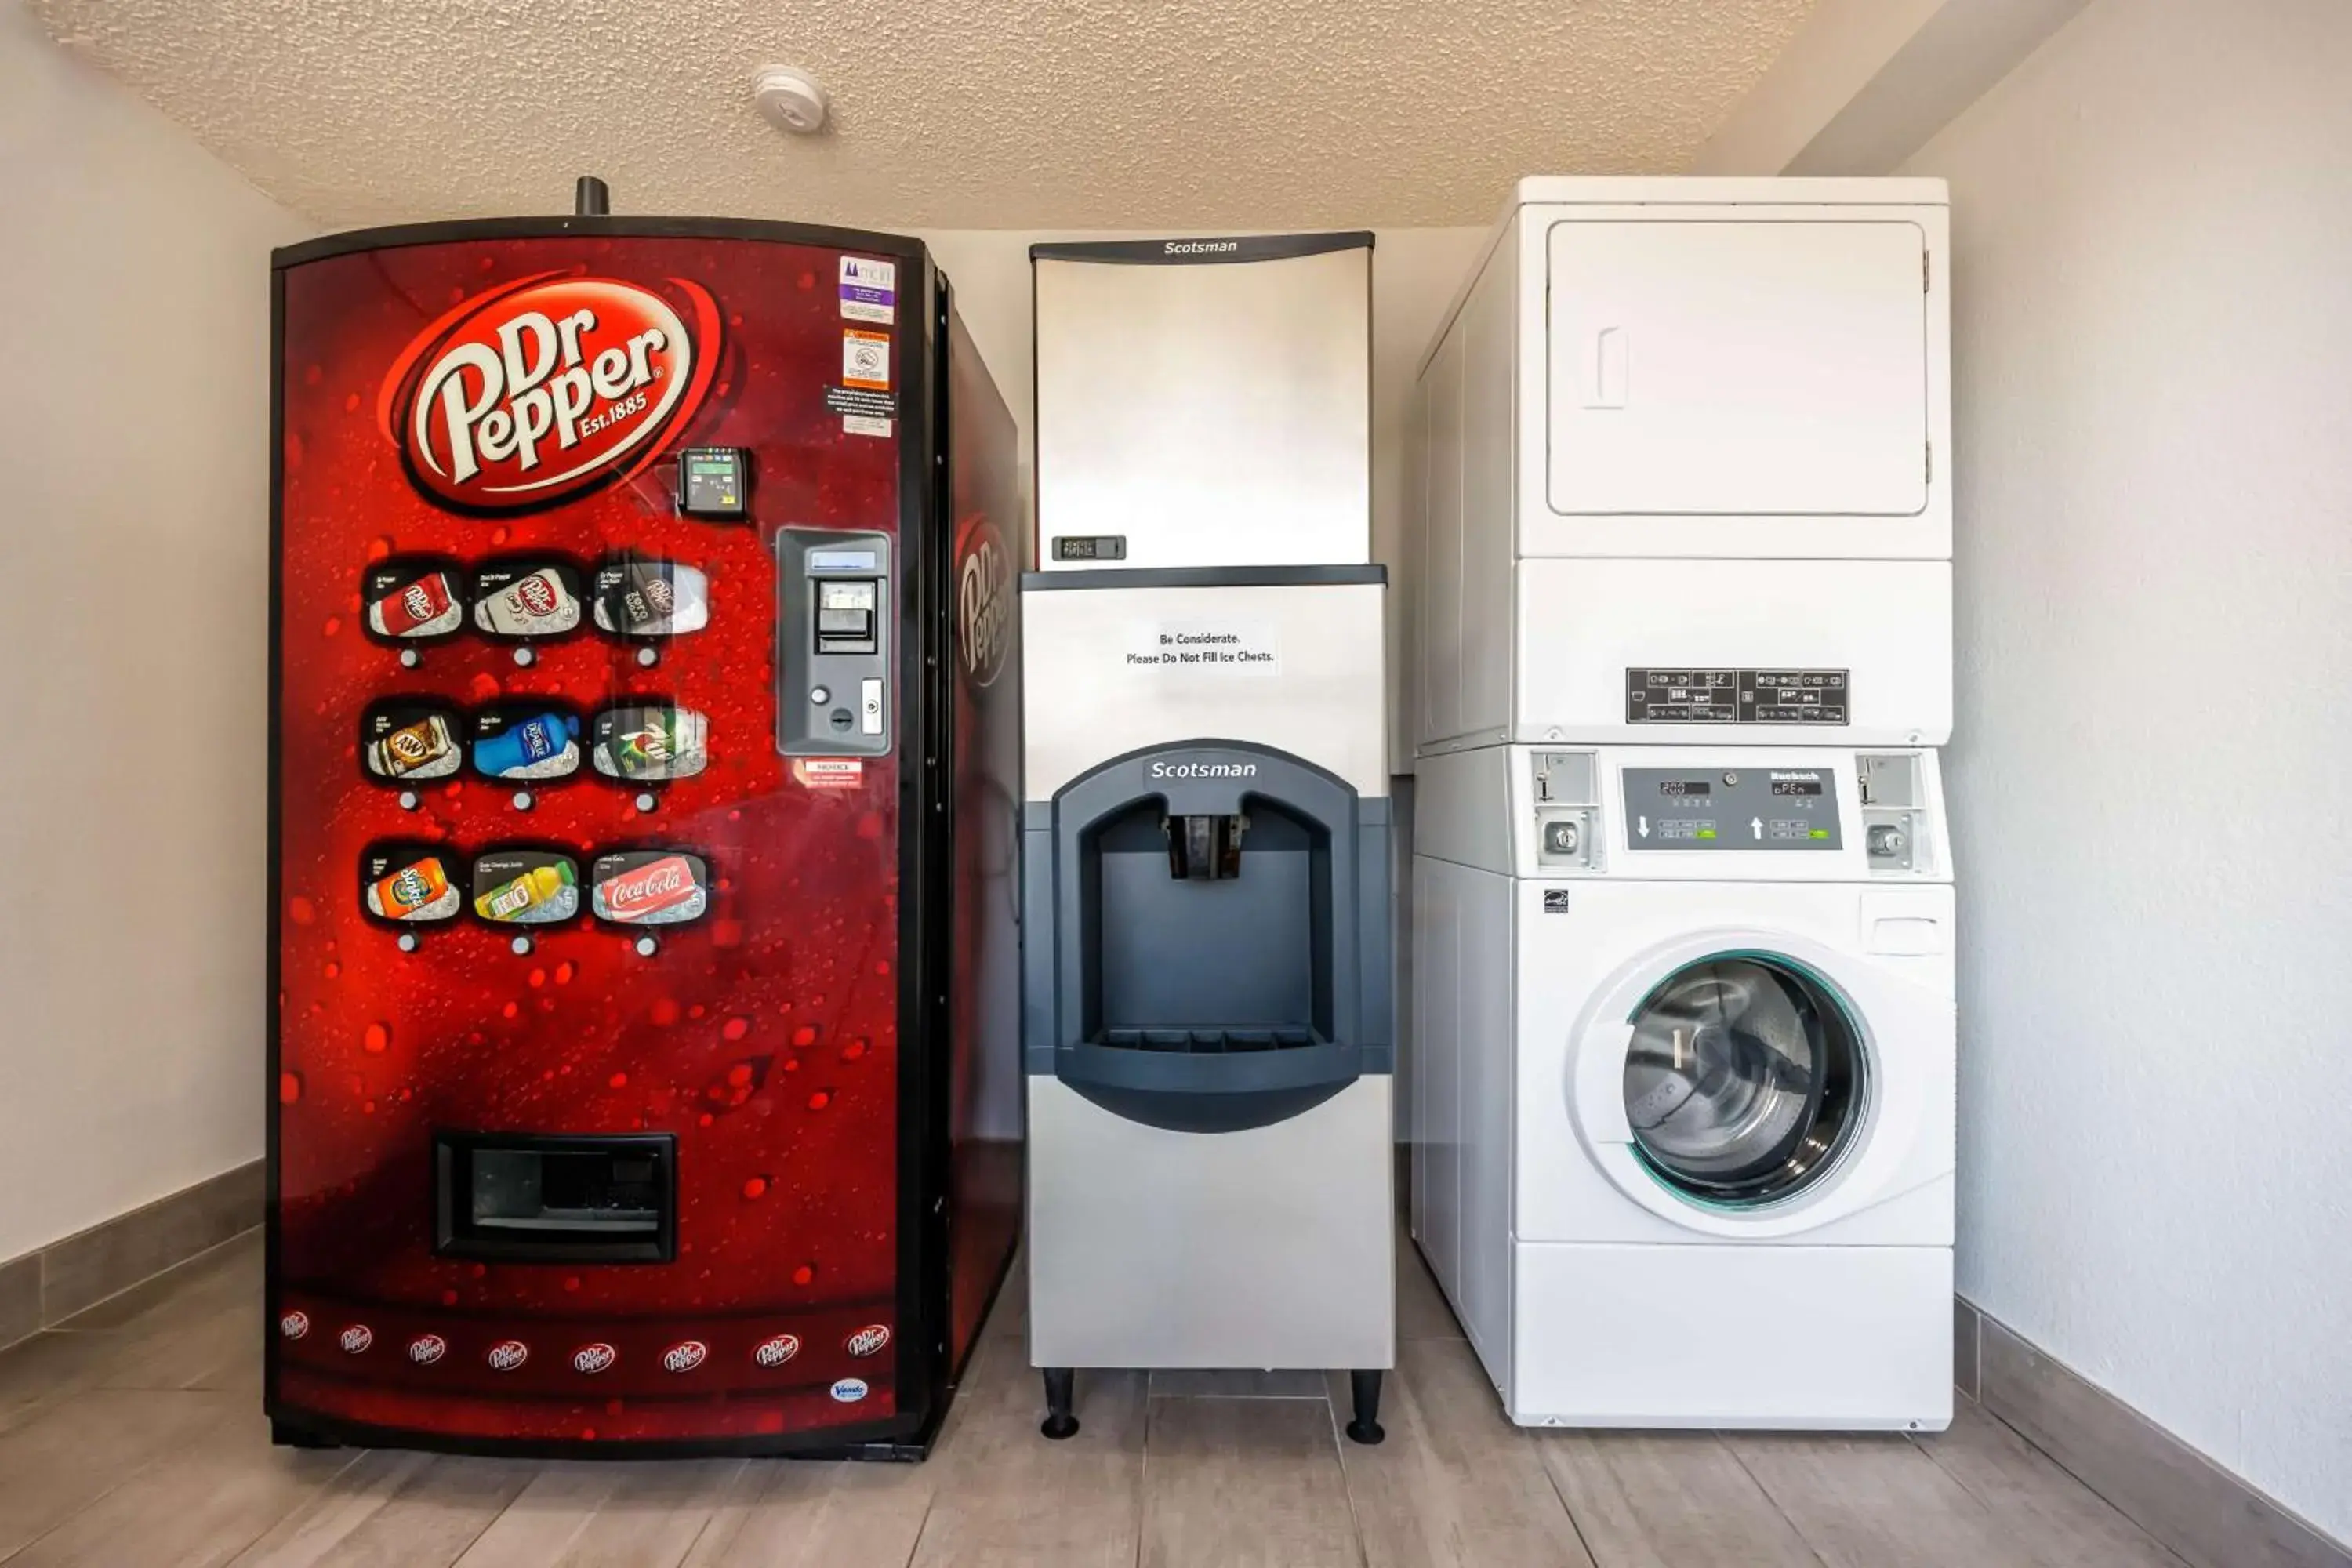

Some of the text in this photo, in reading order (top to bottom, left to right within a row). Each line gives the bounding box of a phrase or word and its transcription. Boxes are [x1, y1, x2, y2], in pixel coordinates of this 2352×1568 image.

[1165, 241, 1237, 255] Scotsman
[496, 309, 597, 398] Dr
[416, 328, 666, 485] Pepper
[1160, 633, 1241, 645] Be Considerate.
[1127, 650, 1274, 664] Please Do Not Fill Ice Chests.
[1151, 761, 1257, 779] Scotsman
[757, 1341, 793, 1365] Pepper
[848, 1331, 884, 1356] Pepper
